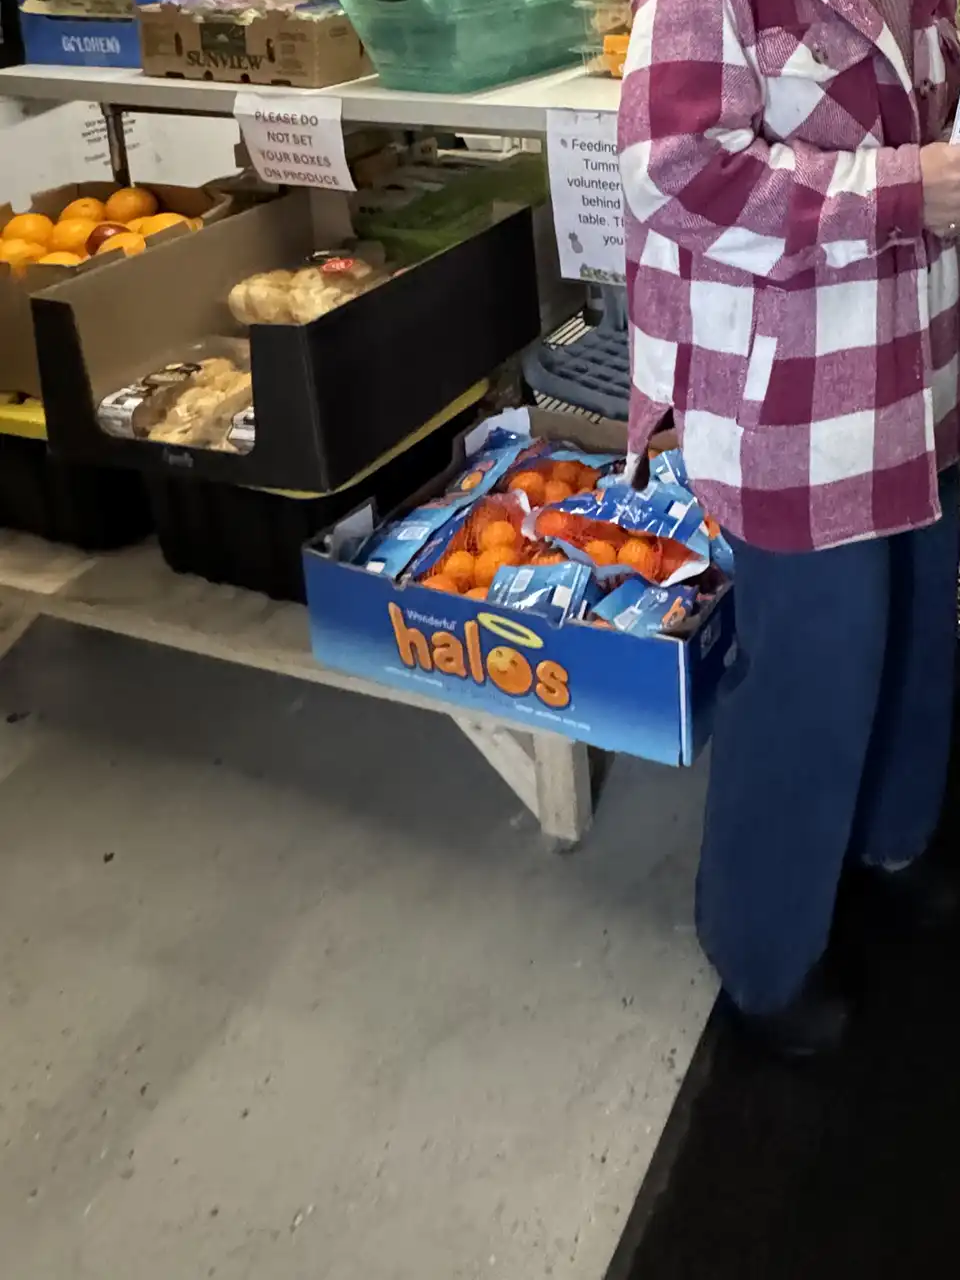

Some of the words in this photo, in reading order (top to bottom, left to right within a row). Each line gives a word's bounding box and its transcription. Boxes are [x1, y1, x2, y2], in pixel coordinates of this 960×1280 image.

[187, 50, 267, 71] SUNVIEW
[255, 109, 298, 125] PLEASE
[301, 115, 318, 127] DO
[267, 131, 289, 143] NOT
[572, 139, 617, 156] Feeding
[260, 150, 291, 162] YOUR
[293, 153, 332, 167] BOXES
[264, 167, 281, 178] ON
[283, 170, 339, 185] PRODUCE
[567, 177, 623, 192] volunteer
[582, 195, 621, 210] behind
[578, 213, 610, 227] table.
[603, 235, 624, 247] you
[406, 608, 457, 631] Wonderful
[388, 601, 571, 708] halos
